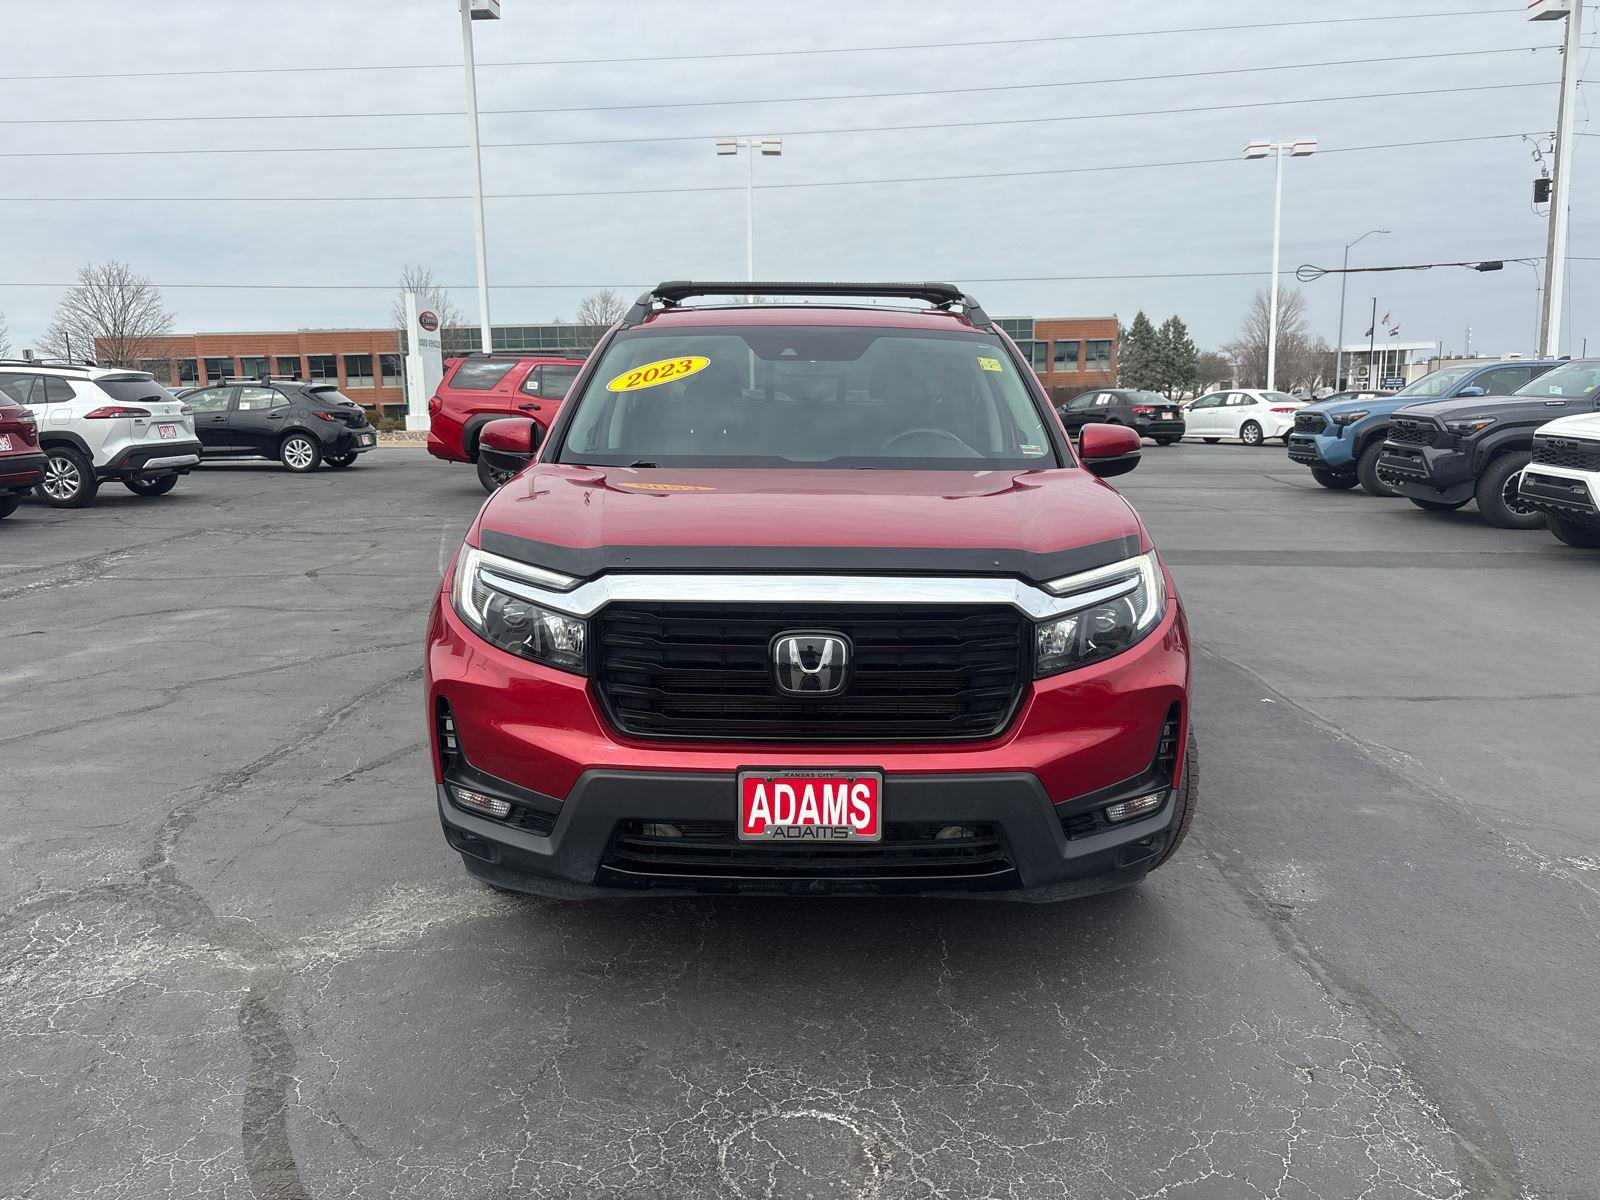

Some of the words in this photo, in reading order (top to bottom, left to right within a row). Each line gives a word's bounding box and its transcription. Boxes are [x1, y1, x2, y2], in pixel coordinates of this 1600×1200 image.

[626, 359, 693, 388] 2023
[747, 783, 871, 829] ADAMS
[772, 826, 849, 839] ADAMS
